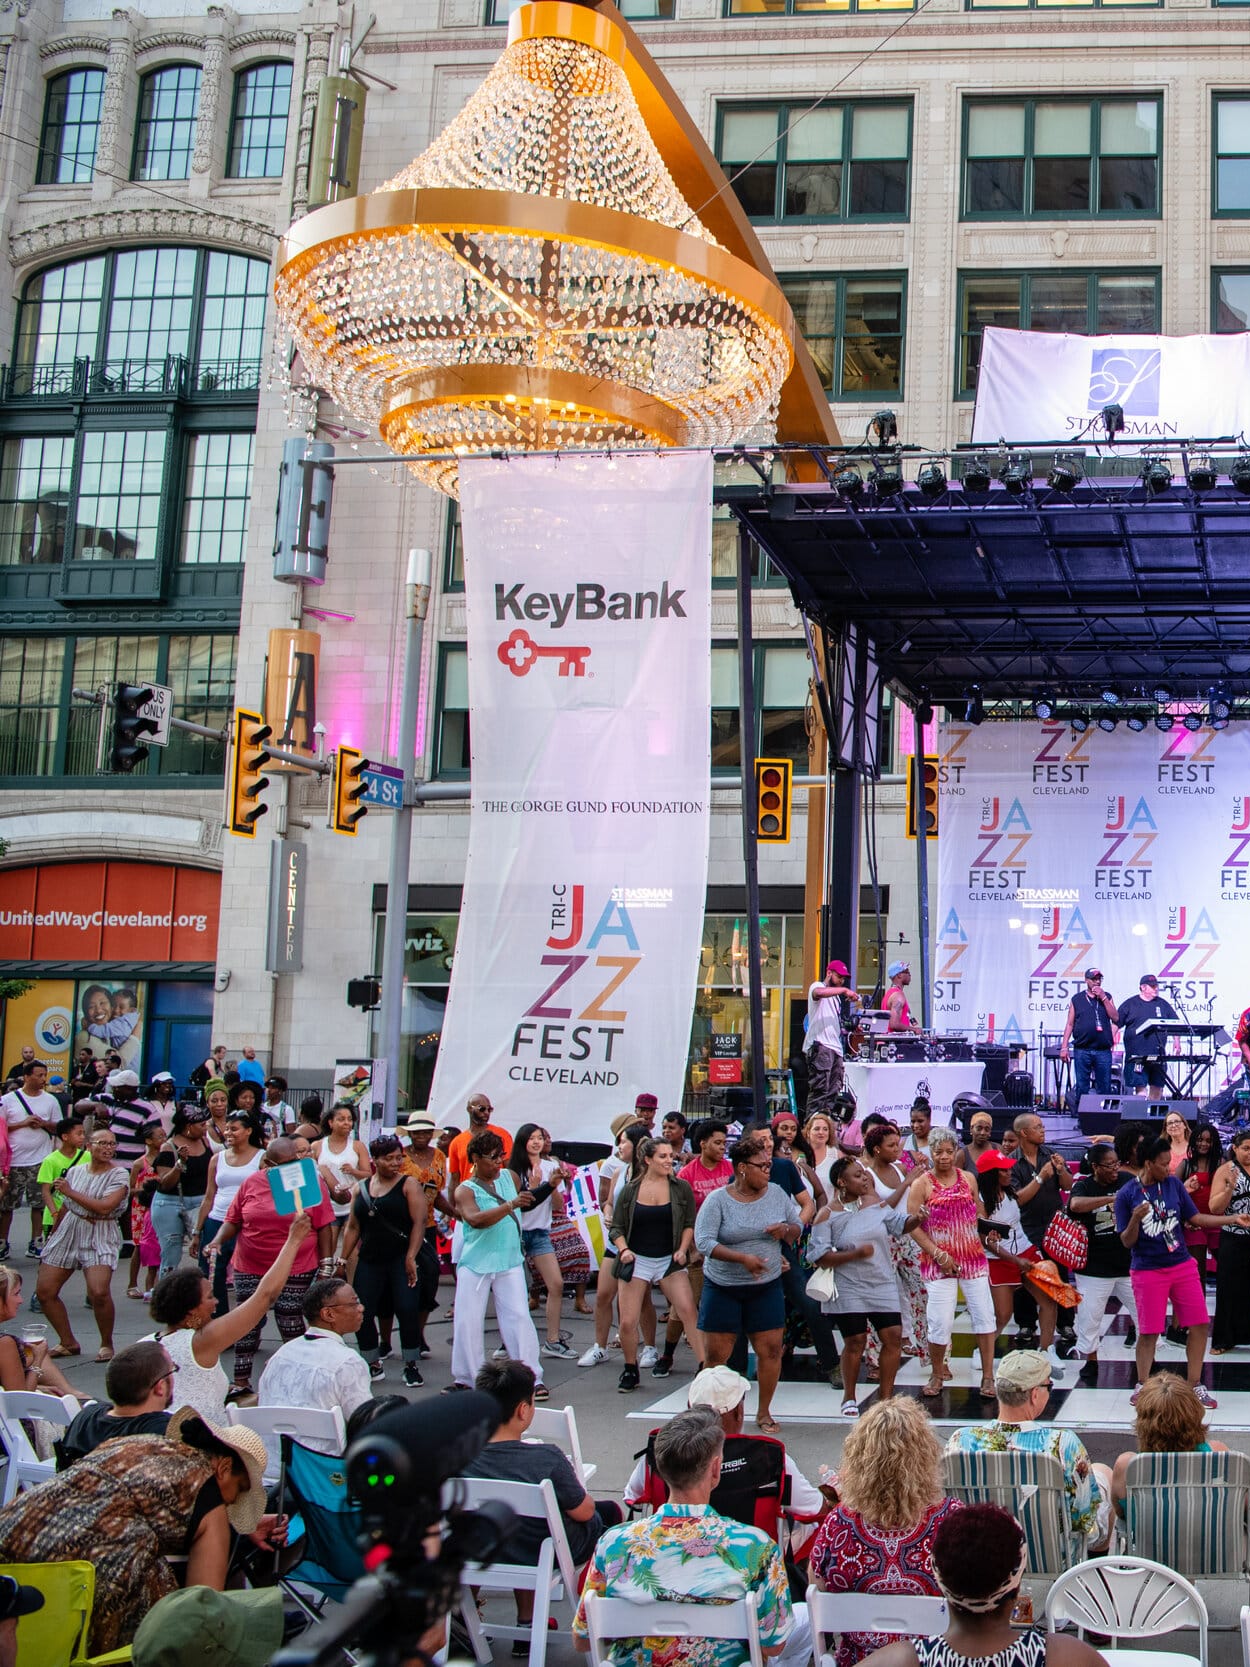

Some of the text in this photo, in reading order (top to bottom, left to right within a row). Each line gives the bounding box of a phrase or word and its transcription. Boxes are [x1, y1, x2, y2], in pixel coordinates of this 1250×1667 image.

[494, 581, 687, 628] KeyBank
[152, 689, 165, 704] US
[143, 703, 166, 719] ONLY
[938, 765, 966, 783] ST
[1032, 764, 1090, 782] FEST
[1158, 764, 1215, 782] FEST
[382, 781, 398, 804] St
[1032, 786, 1090, 796] CLEVELAND
[1158, 786, 1215, 795] CLEVELAND
[482, 800, 508, 813] THE
[566, 800, 607, 813] GUND
[611, 801, 703, 814] FOUNDATION
[982, 797, 991, 821] TRI-C
[1108, 796, 1116, 820] TRI-C
[1233, 796, 1241, 820] TRI-C
[968, 870, 1027, 889] FEST
[1095, 869, 1152, 887] FEST
[1016, 888, 1080, 900] STRASSMAN
[1095, 891, 1152, 900] CLEVELAND
[286, 851, 298, 961] CENTER
[551, 884, 566, 930] TRI-C
[0, 910, 207, 932] UnitedWayCleveland.org
[1169, 906, 1177, 930] TRI-C
[934, 981, 962, 999] ST
[1028, 981, 1086, 999] FEST
[1028, 1003, 1070, 1012] CLEVELA
[511, 1023, 625, 1062] FEST
[715, 1036, 737, 1044] JACK
[508, 1066, 620, 1087] CLEVELAND
[874, 1104, 893, 1113] Follow
